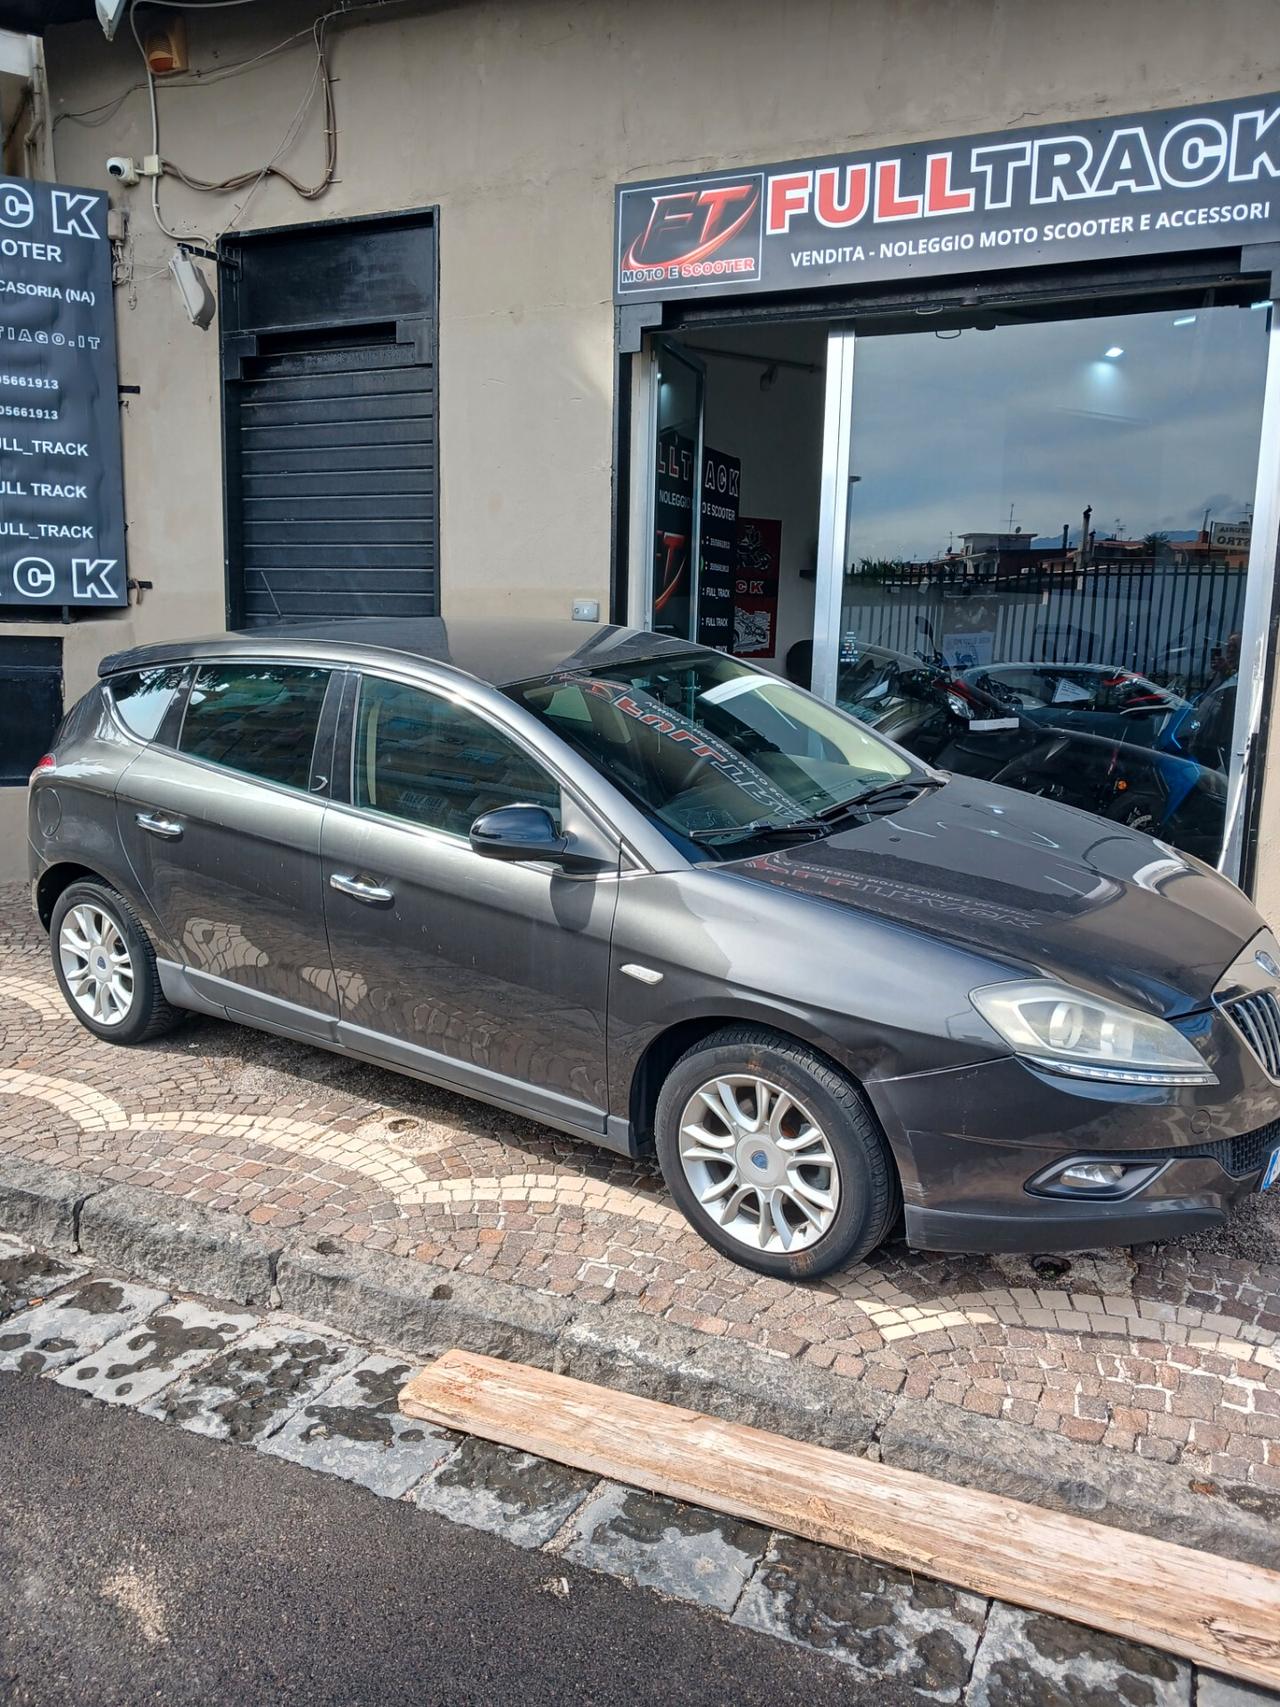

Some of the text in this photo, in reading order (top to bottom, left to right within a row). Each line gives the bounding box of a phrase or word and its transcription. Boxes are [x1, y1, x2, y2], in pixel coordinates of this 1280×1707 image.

[766, 107, 1280, 236] FULLTRACK
[790, 246, 865, 267] VENDITA
[879, 233, 974, 259] NOLEGGIO
[980, 226, 1037, 249] MOTO
[1043, 215, 1134, 242] SCOOTER
[1140, 214, 1150, 231] E
[1155, 201, 1270, 229] ACCESSORI
[622, 258, 755, 283] MOTO E SCOOTER
[65, 288, 95, 306] (NA)
[0, 375, 59, 390] 5661913
[0, 437, 89, 457] LL_TRACK
[30, 482, 88, 499] TRACK
[711, 503, 736, 521] SCOOTER
